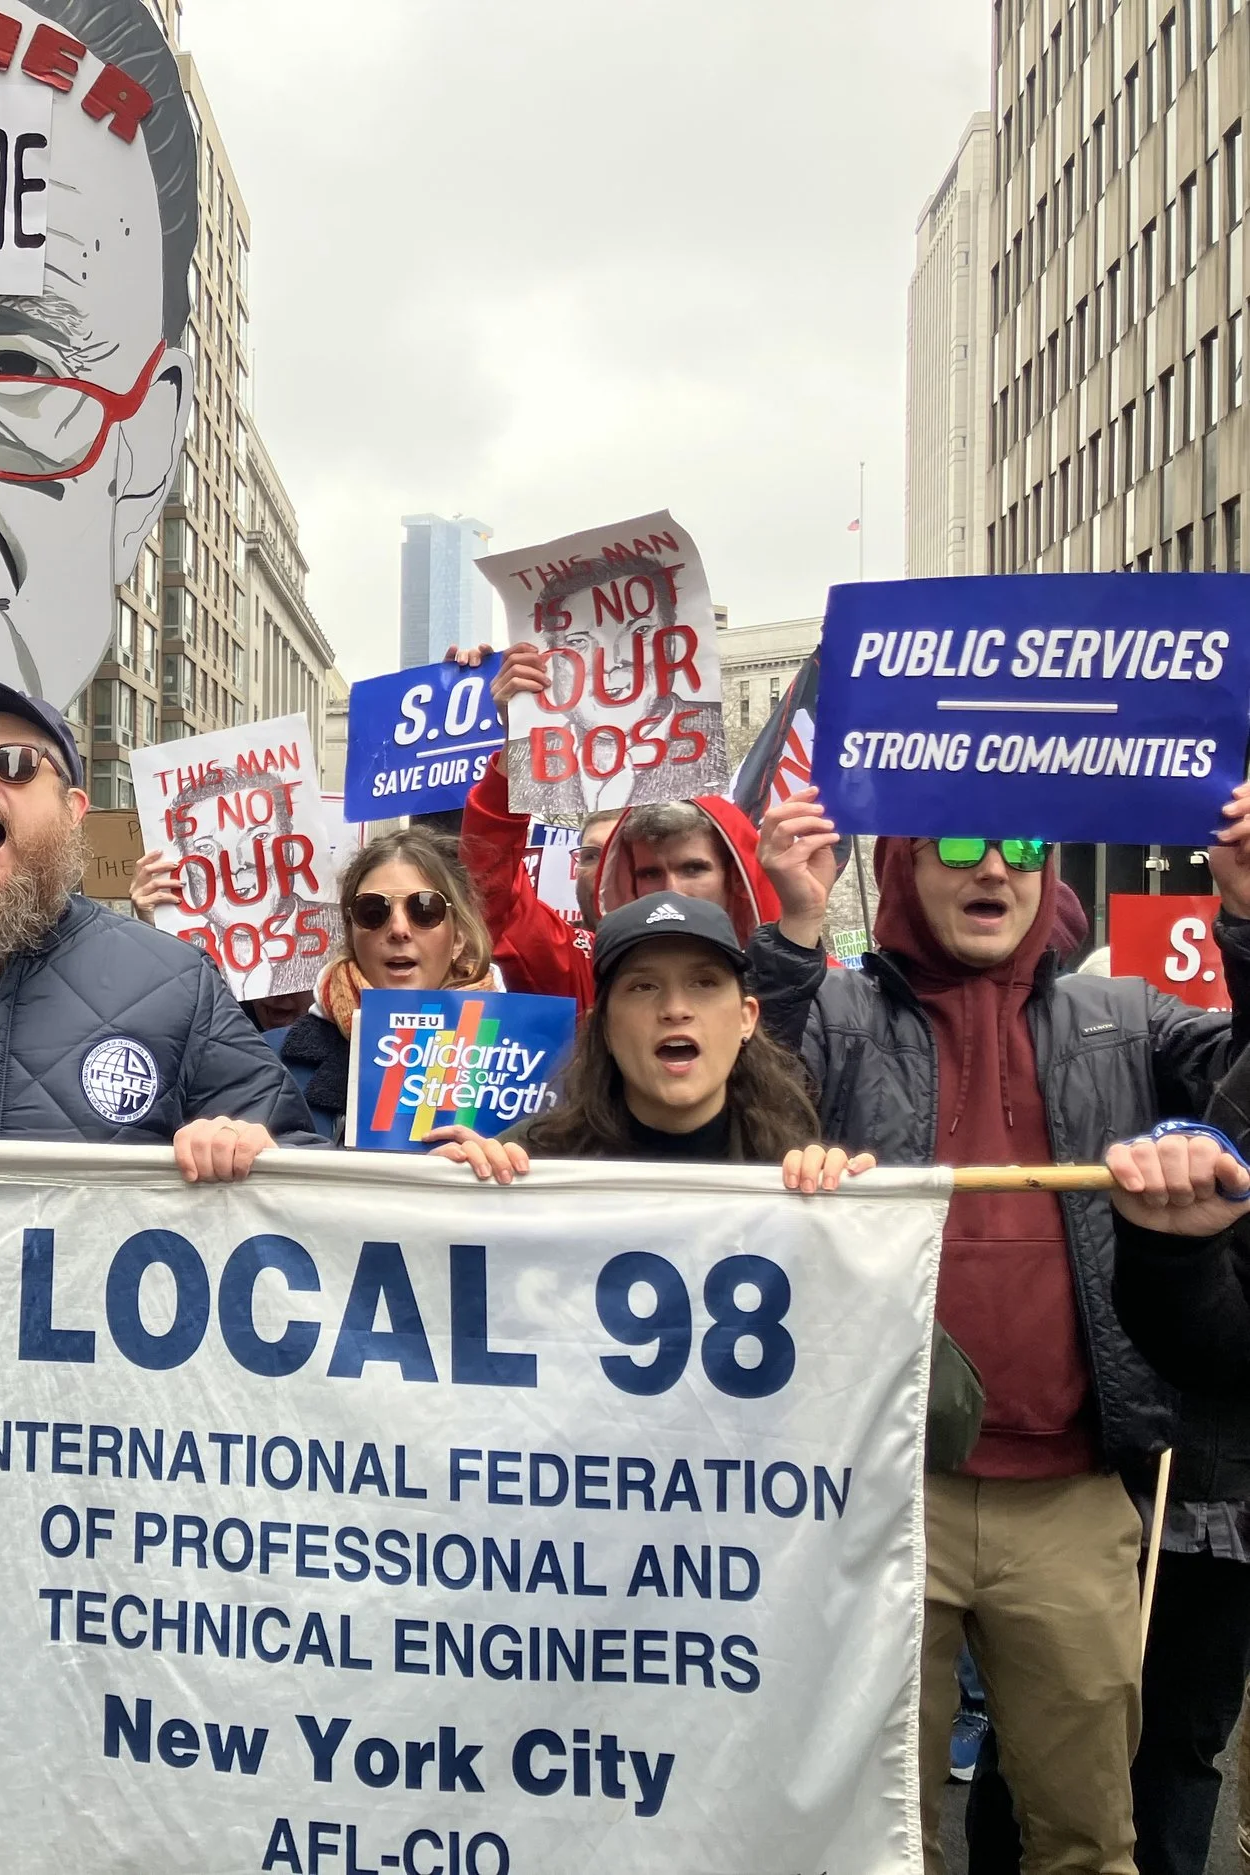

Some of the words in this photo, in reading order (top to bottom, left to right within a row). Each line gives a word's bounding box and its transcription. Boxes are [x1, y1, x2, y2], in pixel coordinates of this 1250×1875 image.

[510, 554, 591, 591] THIS
[602, 531, 680, 565] MAN
[534, 598, 572, 633] IS
[592, 563, 686, 628] NOT
[535, 624, 701, 714] OUR
[851, 630, 1004, 678] PUBLIC
[1011, 629, 1229, 680] SERVICES
[394, 676, 503, 746] S.O.
[153, 759, 223, 796] THIS
[236, 742, 300, 776] MAN
[372, 765, 425, 797] SAVE
[427, 759, 469, 788] OUR
[472, 756, 493, 781] S
[529, 710, 707, 784] BOSS
[839, 731, 969, 769] STRONG
[975, 734, 1216, 778] COMMUNITIES
[165, 802, 198, 842] IS
[216, 780, 303, 831] NOT
[169, 834, 319, 916] OUR
[835, 932, 854, 947] KIDS
[855, 929, 867, 943] AN
[395, 1016, 439, 1027] NTEU
[90, 1068, 152, 1093] IFPTE
[373, 1034, 545, 1082] Solidarity
[455, 1067, 470, 1083] is
[475, 1071, 509, 1086] our
[399, 1074, 557, 1121] Strength
[18, 1228, 537, 1388] LOCAL
[595, 1250, 796, 1399] 98
[449, 1448, 852, 1521] FEDERATION
[40, 1504, 116, 1559] OF
[134, 1511, 607, 1597] PROFESSIONAL
[626, 1544, 761, 1601] AND
[39, 1588, 372, 1670] TECHNICAL
[394, 1618, 761, 1694] ENGINEERS
[103, 1693, 269, 1776] New
[295, 1714, 486, 1793] York
[512, 1728, 676, 1818] City
[261, 1817, 510, 1875] AFL-CIO
